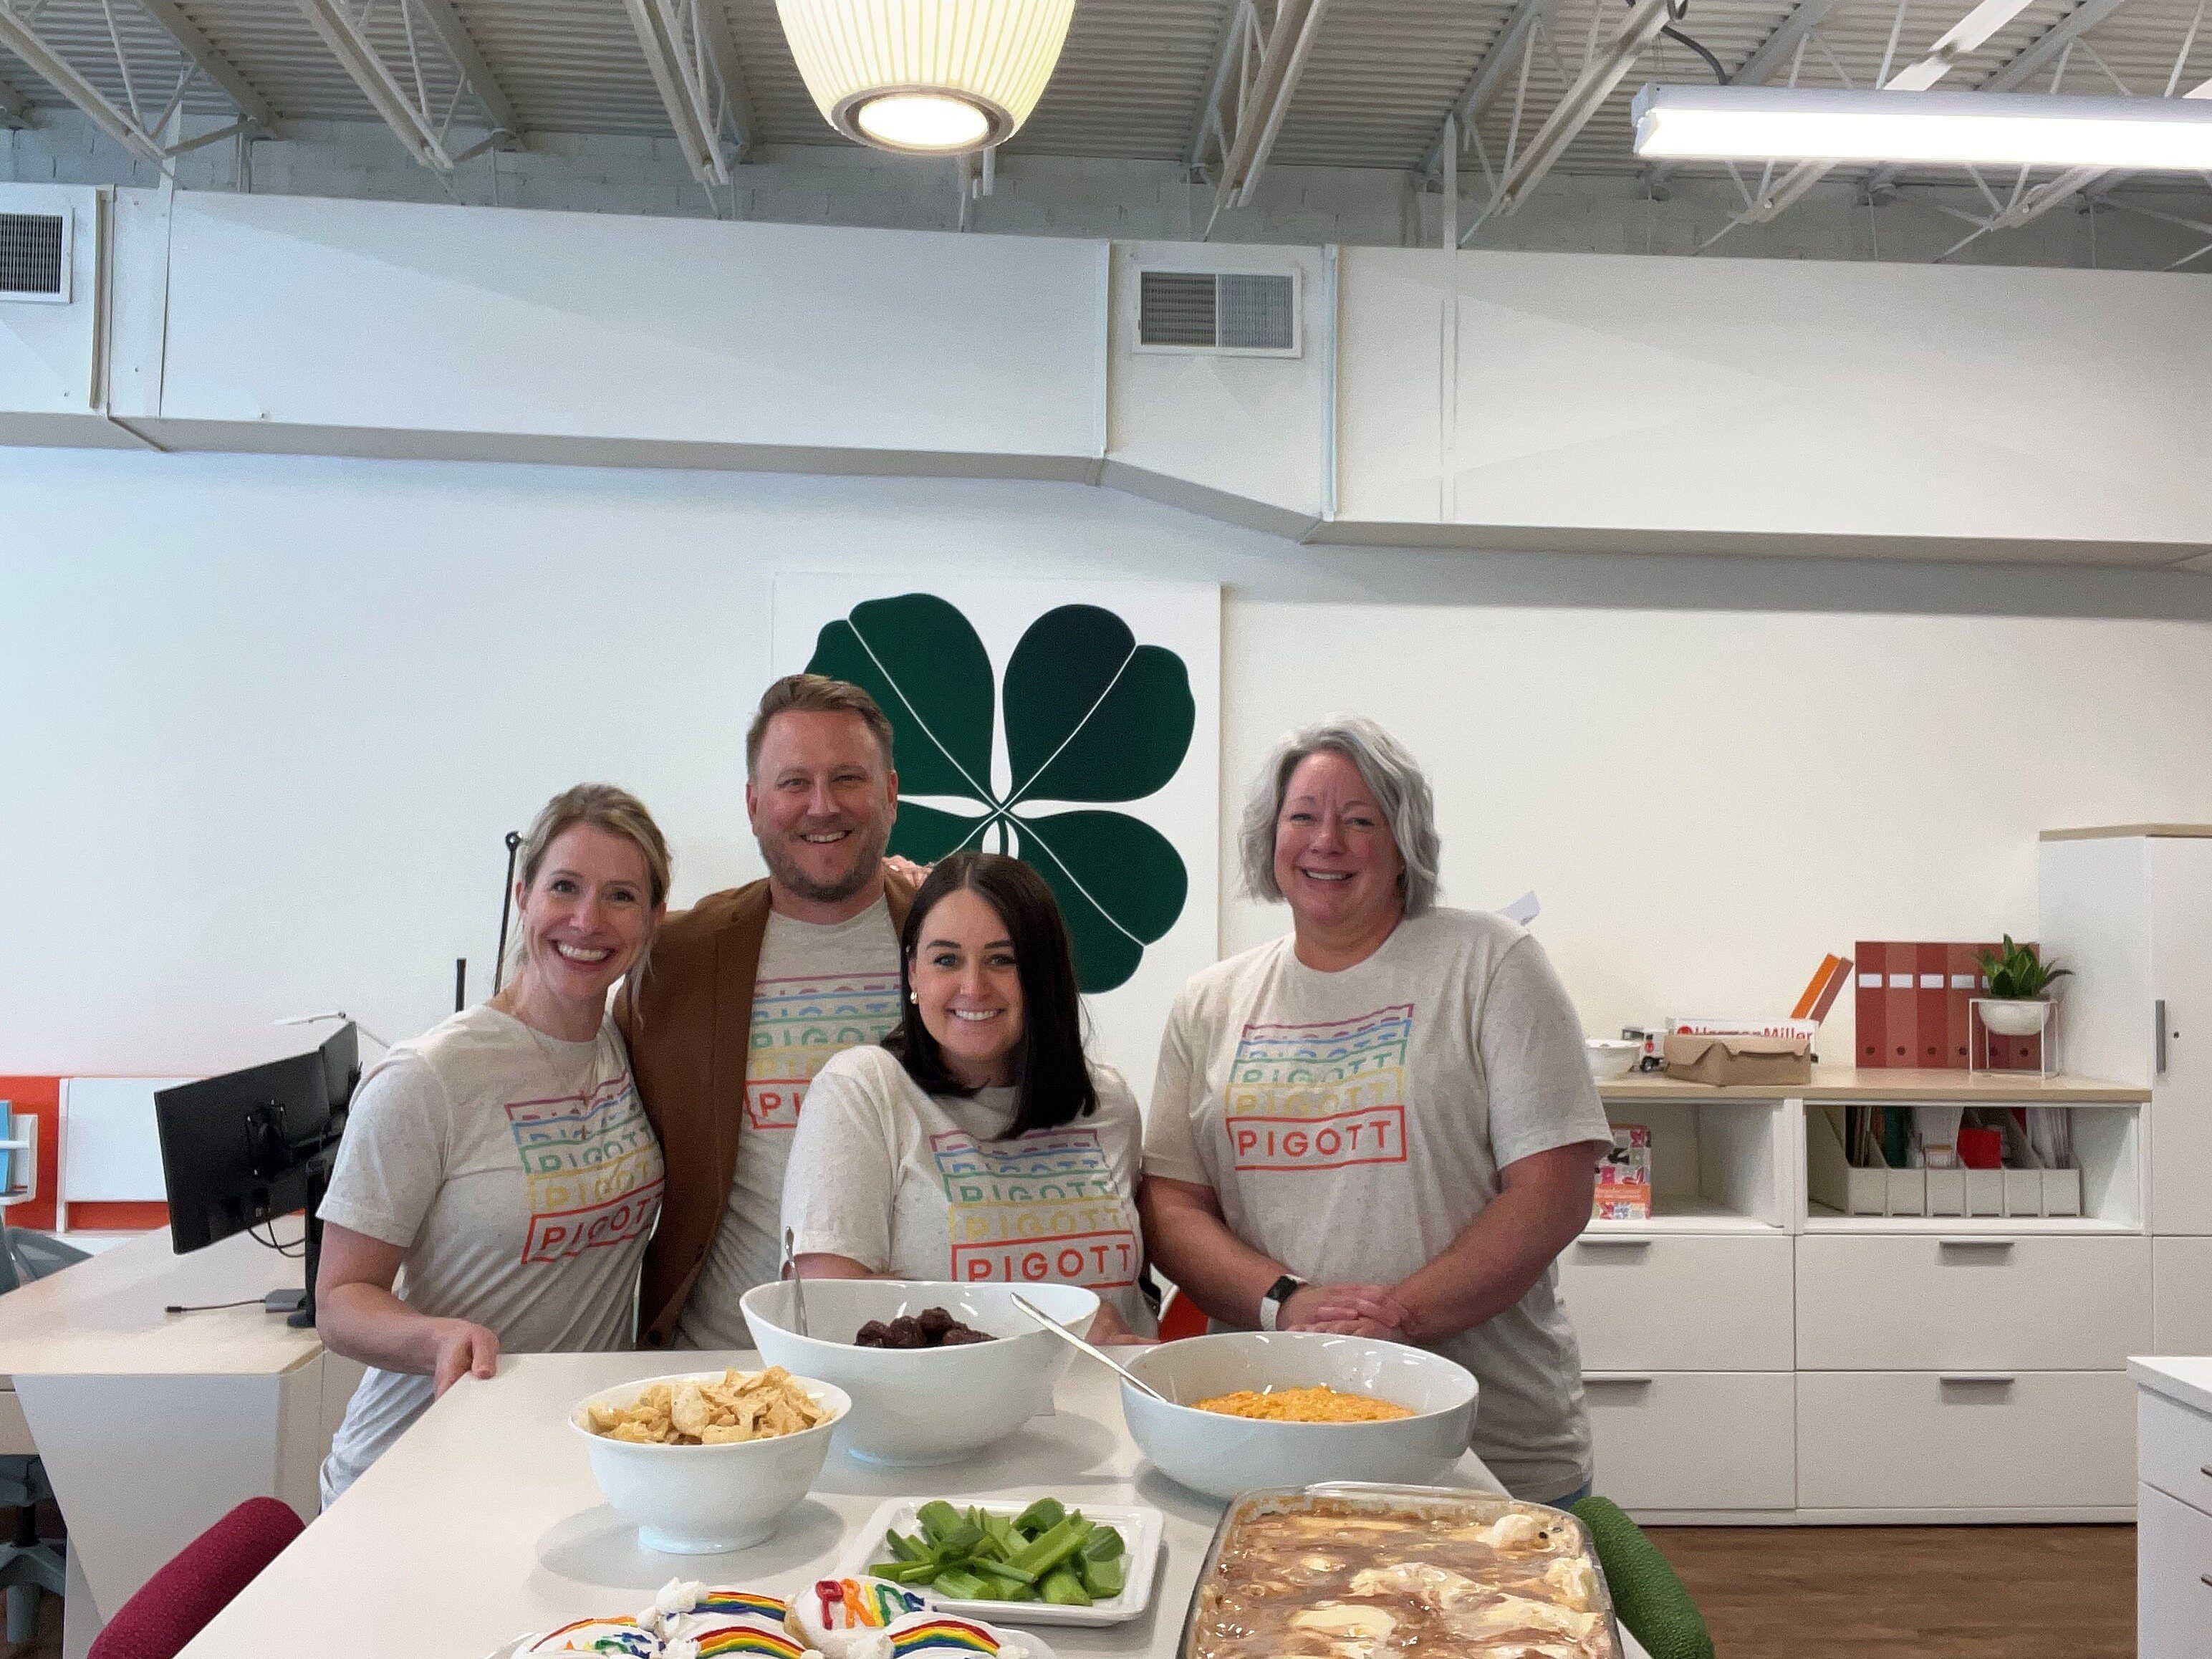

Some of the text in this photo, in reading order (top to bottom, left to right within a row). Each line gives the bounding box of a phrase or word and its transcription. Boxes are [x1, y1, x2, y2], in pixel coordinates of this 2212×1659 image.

[538, 1131, 645, 1172] PIGOT
[1237, 1120, 1391, 1158] PIGOTT
[546, 1160, 650, 1210] PIGOT
[968, 1244, 1130, 1282] PIGOTT
